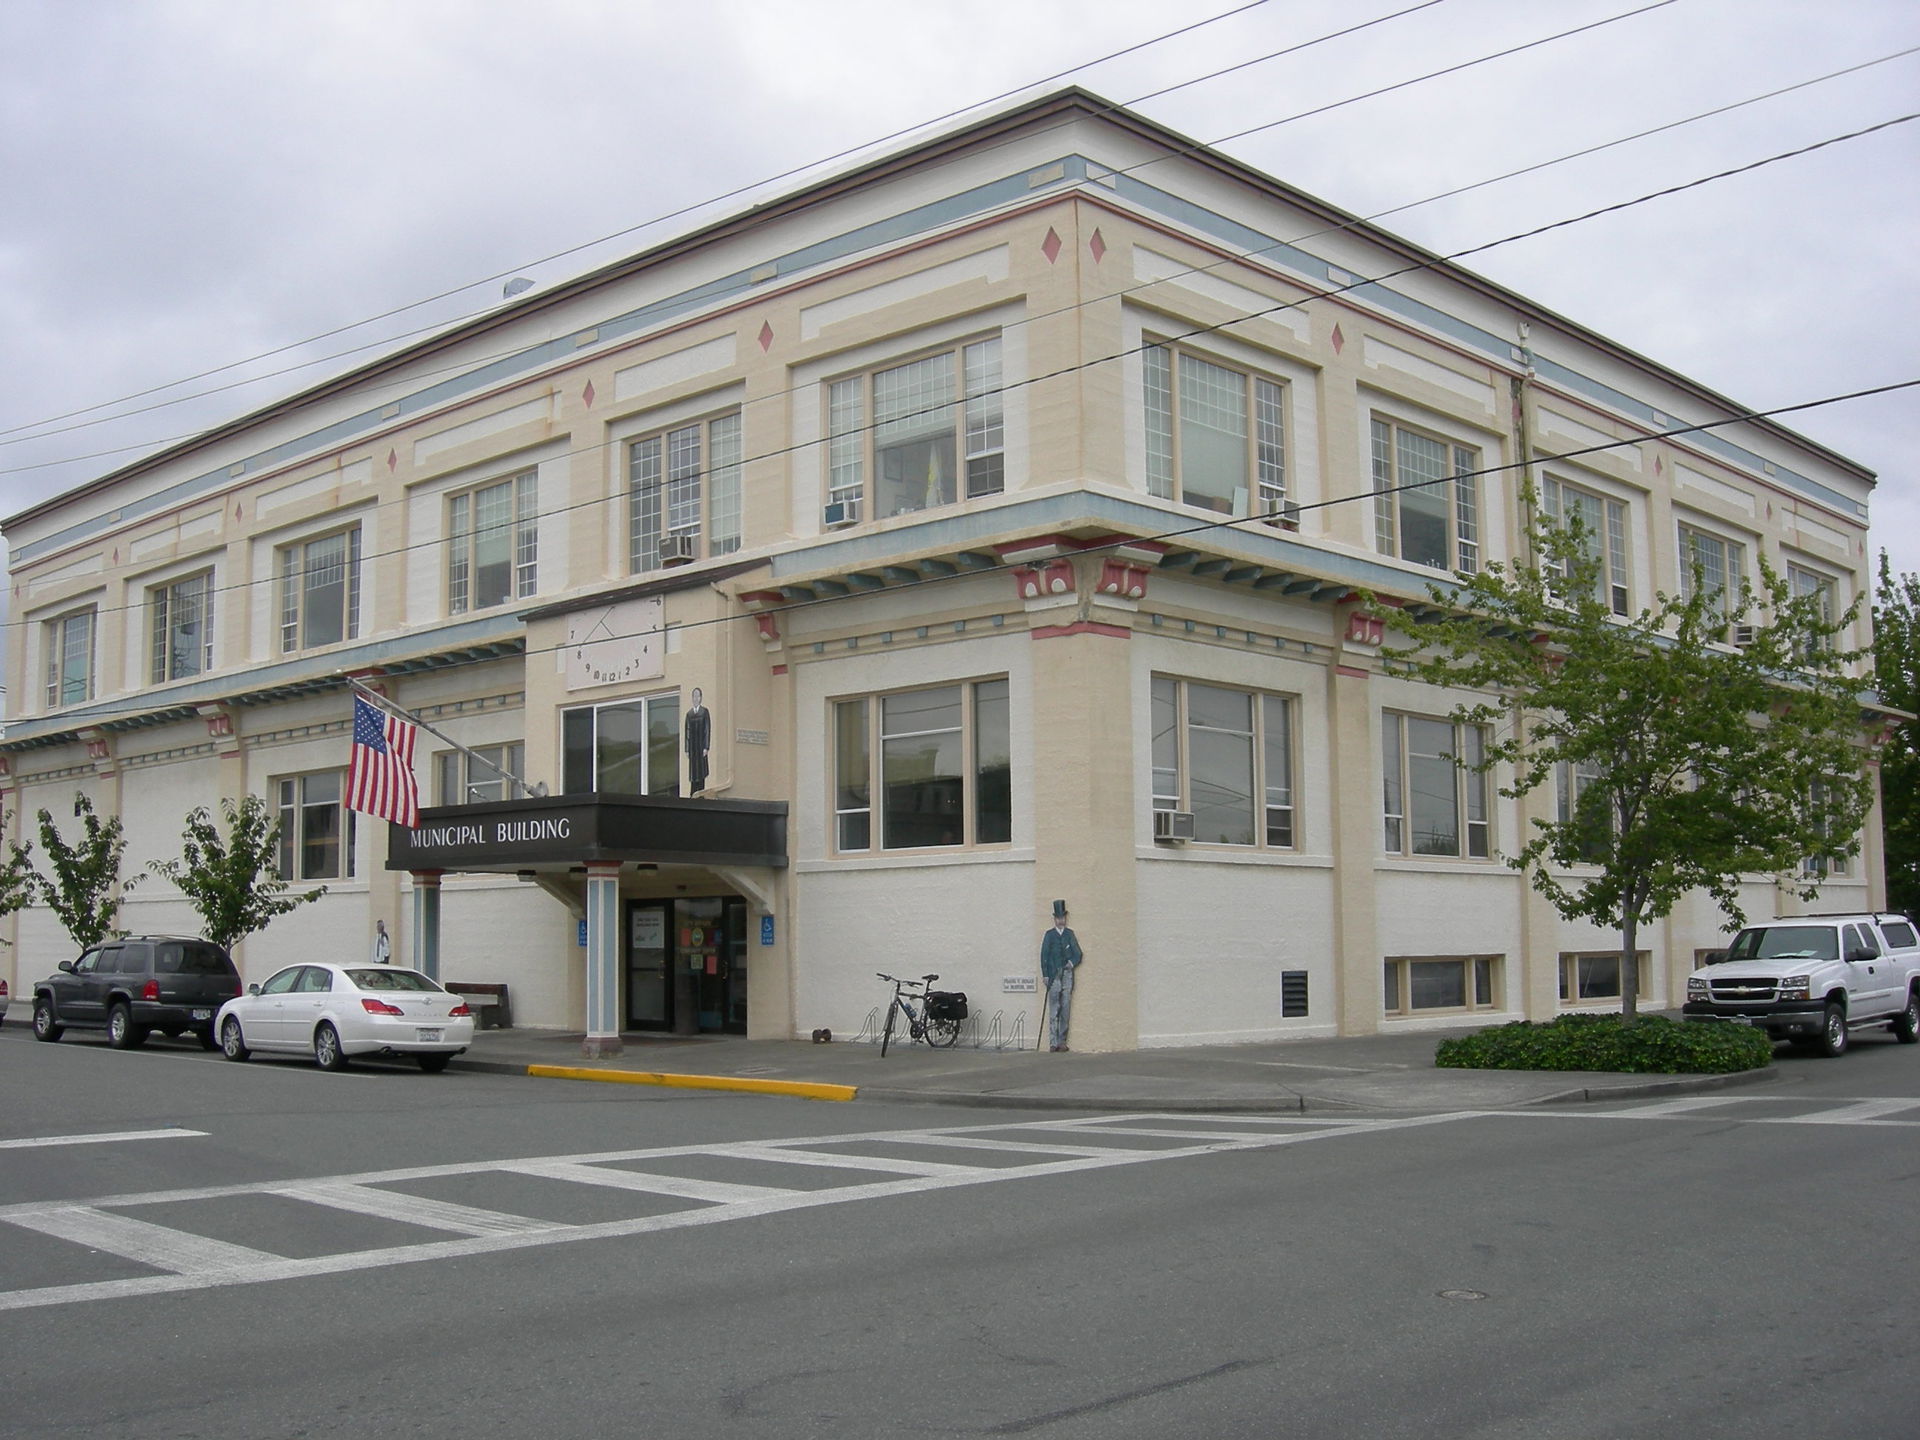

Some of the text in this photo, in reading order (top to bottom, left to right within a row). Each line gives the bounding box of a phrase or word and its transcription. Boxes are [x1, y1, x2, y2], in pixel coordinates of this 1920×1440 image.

[656, 596, 662, 606] 6
[570, 630, 575, 639] 7
[643, 645, 648, 654] 4
[577, 651, 582, 659] 8
[585, 664, 591, 672] 9
[635, 659, 640, 668] 3
[593, 671, 600, 680] 10
[626, 667, 631, 675] 2
[609, 673, 615, 681] 12
[411, 818, 570, 848] MUNICIPAL BUILDING
